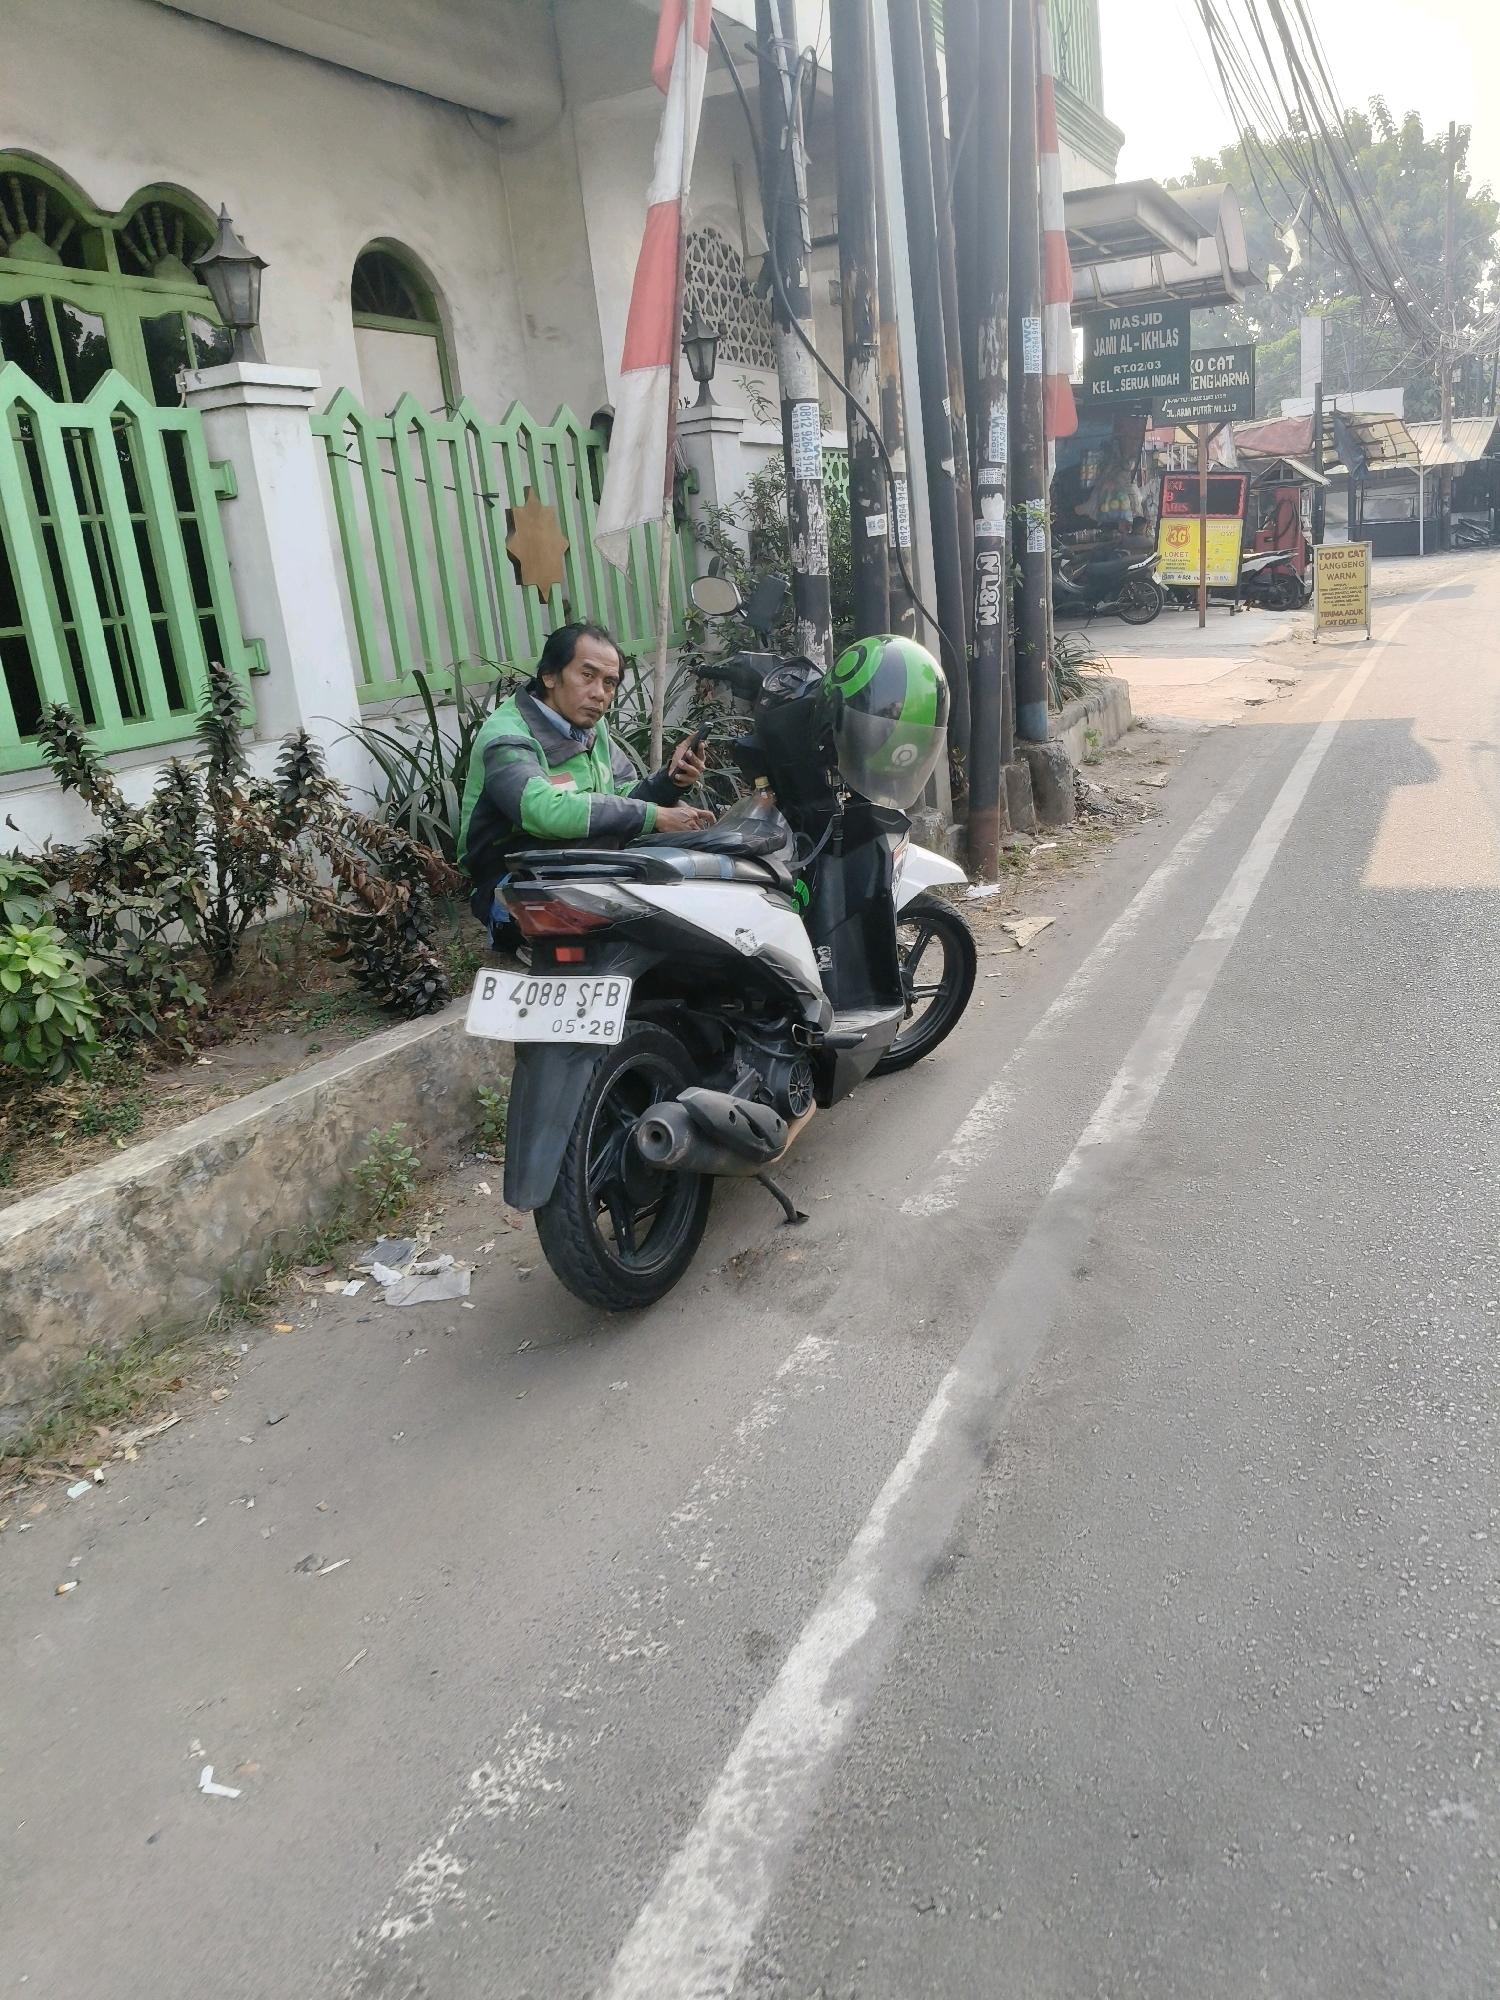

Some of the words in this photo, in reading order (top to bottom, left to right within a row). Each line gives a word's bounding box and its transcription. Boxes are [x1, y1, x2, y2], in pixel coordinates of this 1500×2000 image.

[1109, 312, 1163, 331] MASJID
[1093, 335, 1117, 357] JAMI
[1113, 360, 1162, 375] RT.02/03
[1207, 354, 1235, 371] CAT
[1120, 376, 1150, 392] SERUA
[1151, 372, 1180, 388] INDAH
[799, 405, 812, 428] 0812
[1192, 403, 1213, 416] PUTRA
[801, 430, 814, 453] 9264
[803, 455, 815, 478] 9141
[1170, 529, 1187, 543] 3G
[1318, 551, 1345, 560] TOKO
[1347, 549, 1365, 558] CAT
[1319, 560, 1365, 571] LANGGENG
[1326, 572, 1357, 581] WARNA
[1344, 608, 1364, 616] ADUK
[482, 976, 497, 1001] B
[509, 980, 567, 1007] 4088
[576, 982, 621, 1007] SFB
